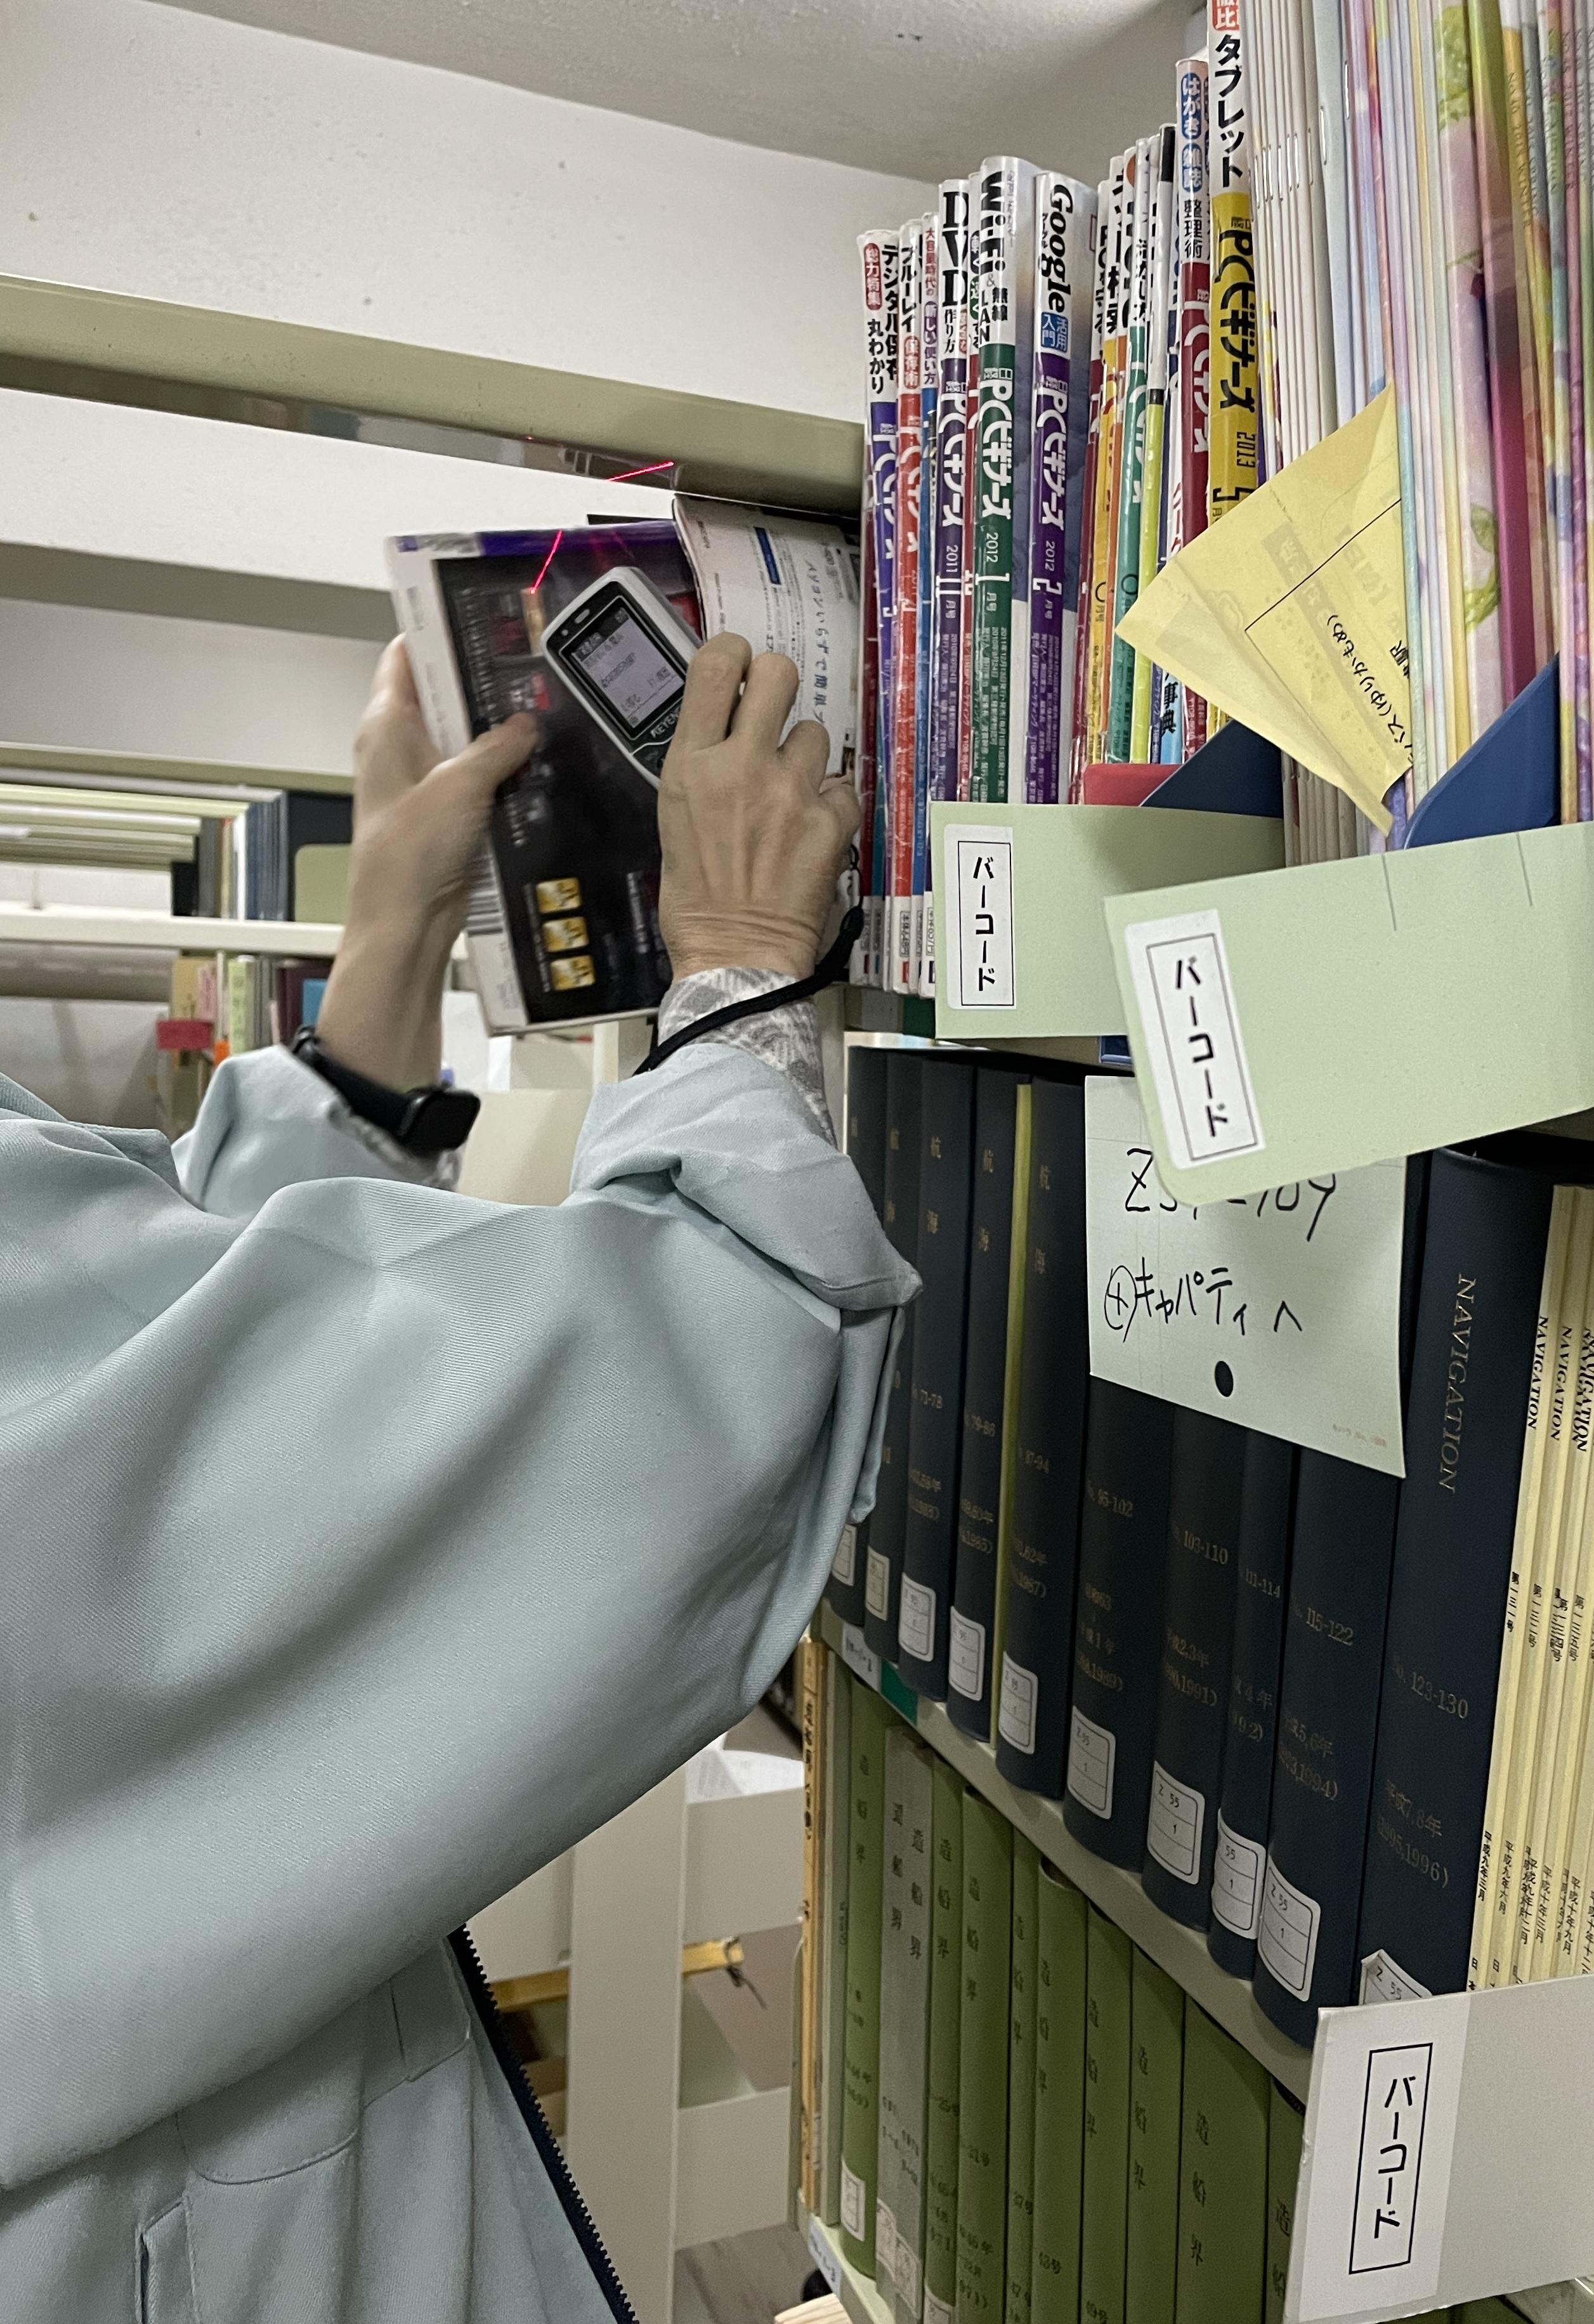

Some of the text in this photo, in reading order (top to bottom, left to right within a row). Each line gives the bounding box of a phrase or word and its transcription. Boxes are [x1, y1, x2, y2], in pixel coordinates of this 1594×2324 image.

[1184, 77, 1200, 136] はがき
[1215, 35, 1244, 188] タブレット
[943, 192, 969, 307] DVD
[981, 171, 1005, 275] Wi-Fi
[1040, 184, 1073, 313] Google
[1184, 198, 1203, 259] 整理術
[925, 303, 937, 342] 新しい
[980, 290, 990, 344] LAN
[992, 287, 1008, 321] 無線
[1042, 315, 1055, 347] 入門
[1219, 228, 1257, 411] PCビギナーズ
[868, 318, 884, 394] 丸わかり
[1057, 316, 1068, 351] 活用
[924, 347, 937, 384] 使い方
[979, 380, 1013, 519] PCビギナーズ
[1036, 387, 1068, 531] PCビギナーズ
[1237, 432, 1256, 467] 2013
[946, 545, 958, 572] 2011
[986, 533, 998, 563] 2012
[1045, 541, 1055, 571] 2012
[650, 707, 679, 738] KEYEN
[972, 857, 995, 992] バーコード
[1175, 956, 1229, 1137] バーコード
[1439, 1273, 1477, 1494] NAVIGATION
[1528, 1316, 1548, 1429] NAVIGATION
[1550, 1326, 1572, 1441] NAVIGATION
[1306, 1607, 1354, 1647] 115-122
[1411, 1675, 1468, 1719] 123-130
[1169, 1793, 1180, 1808] 55
[1278, 1895, 1288, 1912] 55
[1280, 1927, 1285, 1939] 1
[1373, 2075, 1416, 2239] バーコード
